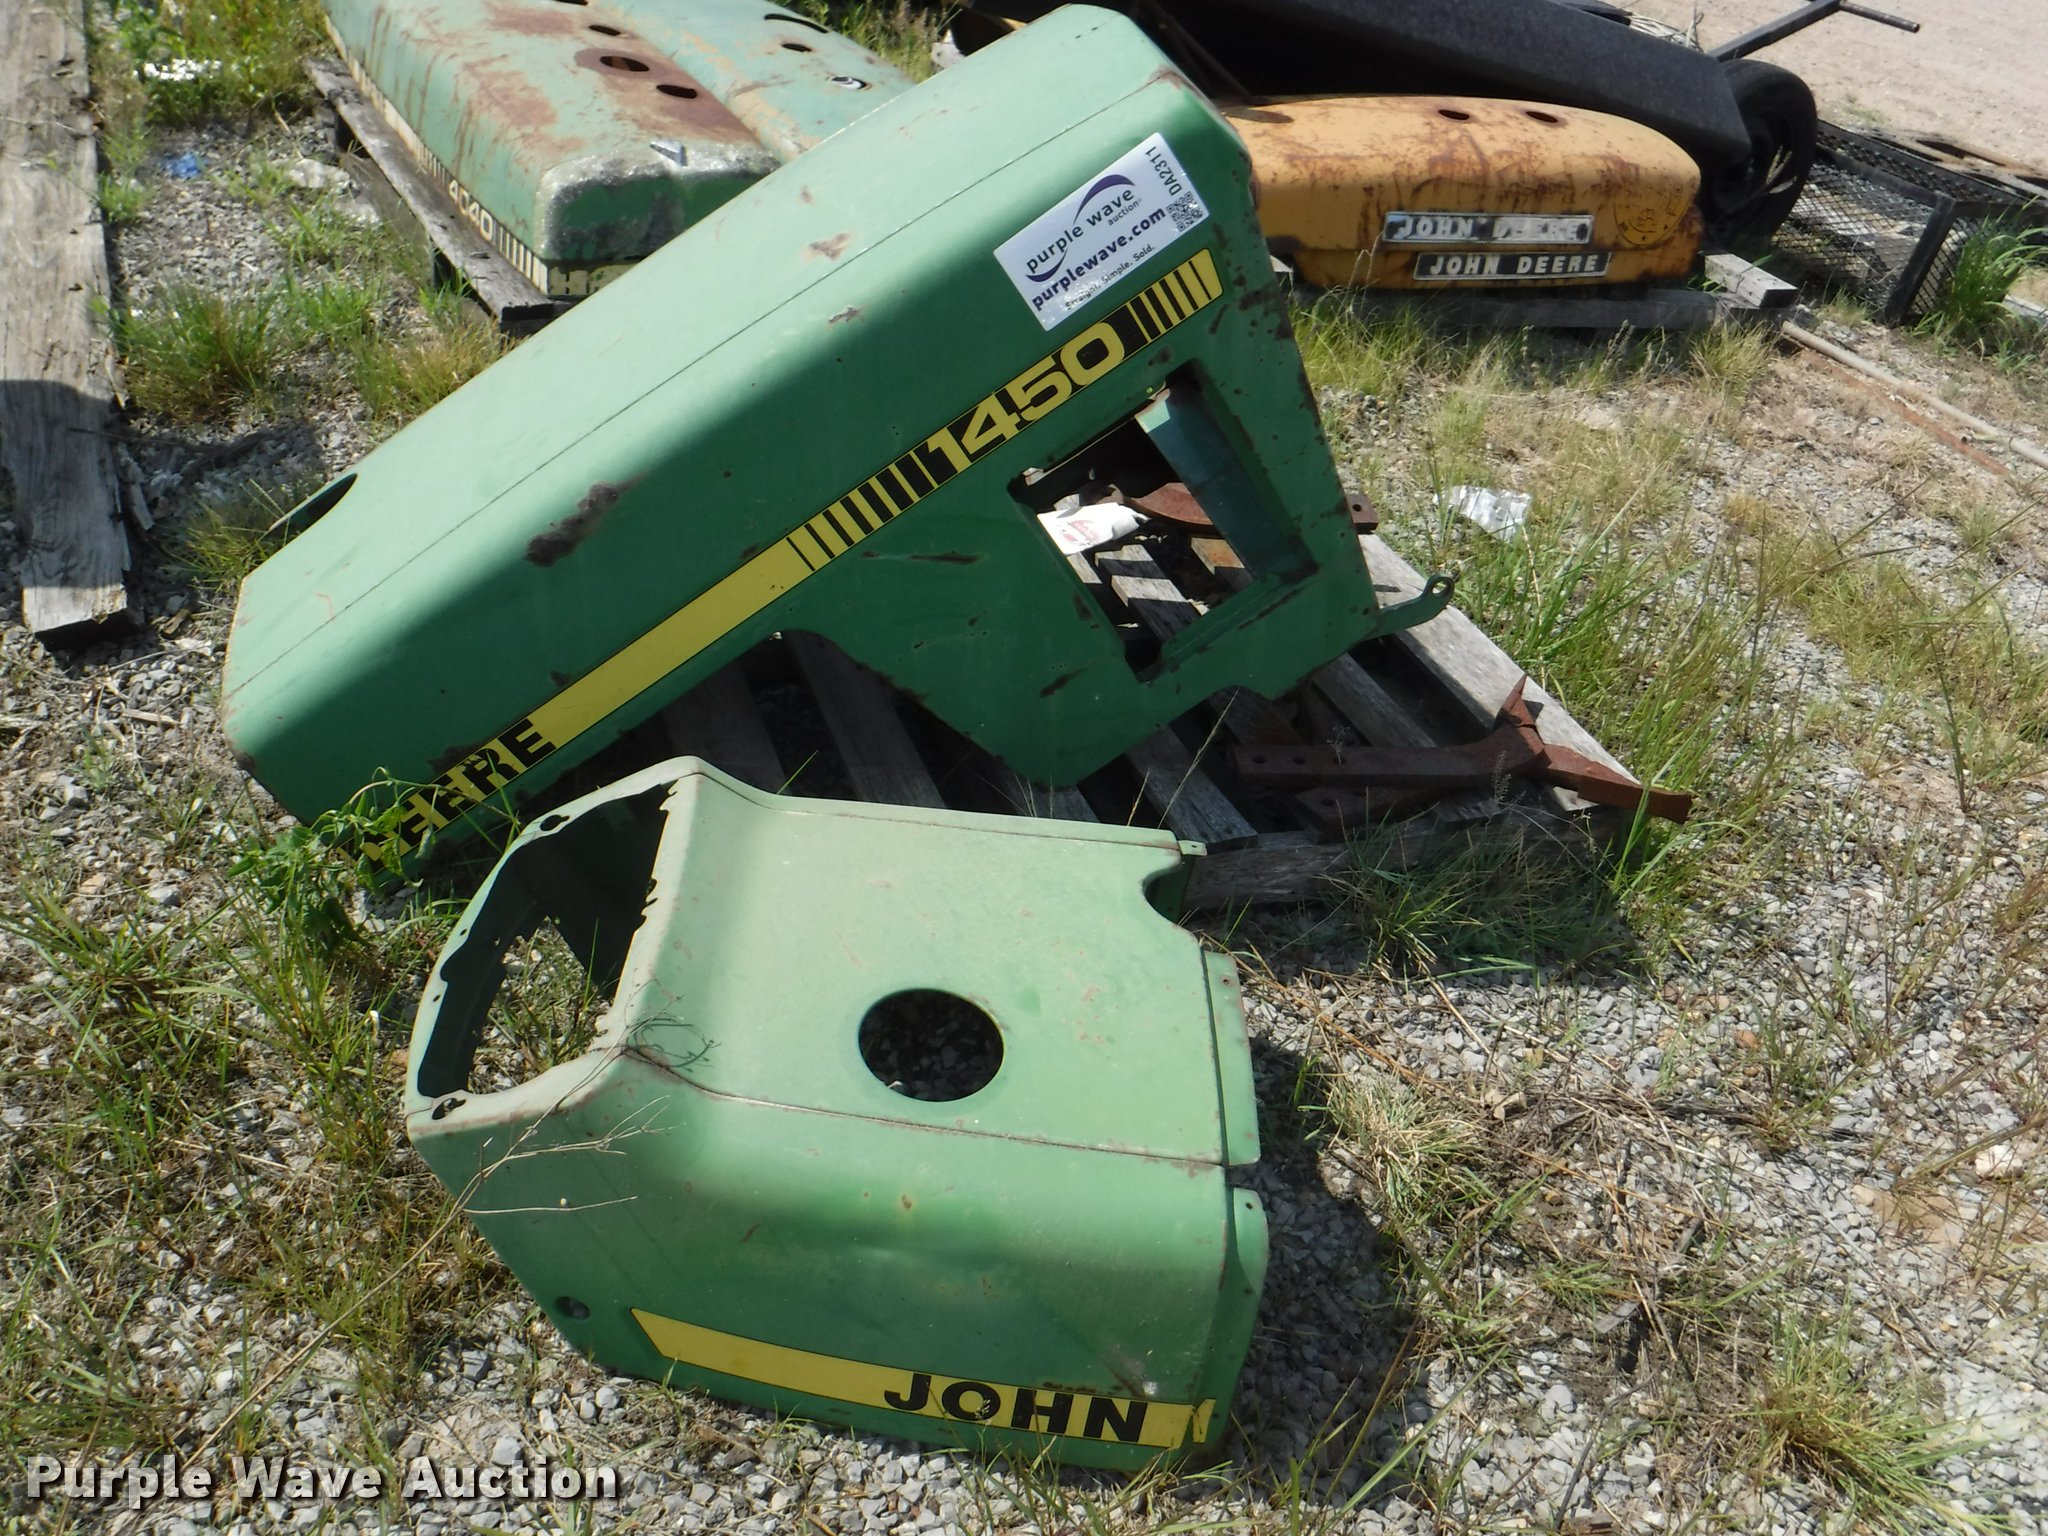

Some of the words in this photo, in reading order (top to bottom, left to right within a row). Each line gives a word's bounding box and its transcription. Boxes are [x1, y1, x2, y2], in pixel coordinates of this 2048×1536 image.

[1145, 146, 1182, 196] DA2311
[449, 179, 494, 241] 4040
[1026, 225, 1084, 274] purple
[1086, 188, 1135, 227] wave
[1107, 200, 1140, 226] auction
[1396, 215, 1474, 238] JOHN
[1031, 207, 1166, 311] purplewave.com
[1101, 262, 1133, 284] Simple.
[1132, 244, 1155, 262] Sold.
[1429, 257, 1500, 275] JOHN
[1516, 254, 1599, 274] DEERE
[926, 321, 1125, 474] 1450
[884, 1372, 1149, 1443] JOHN
